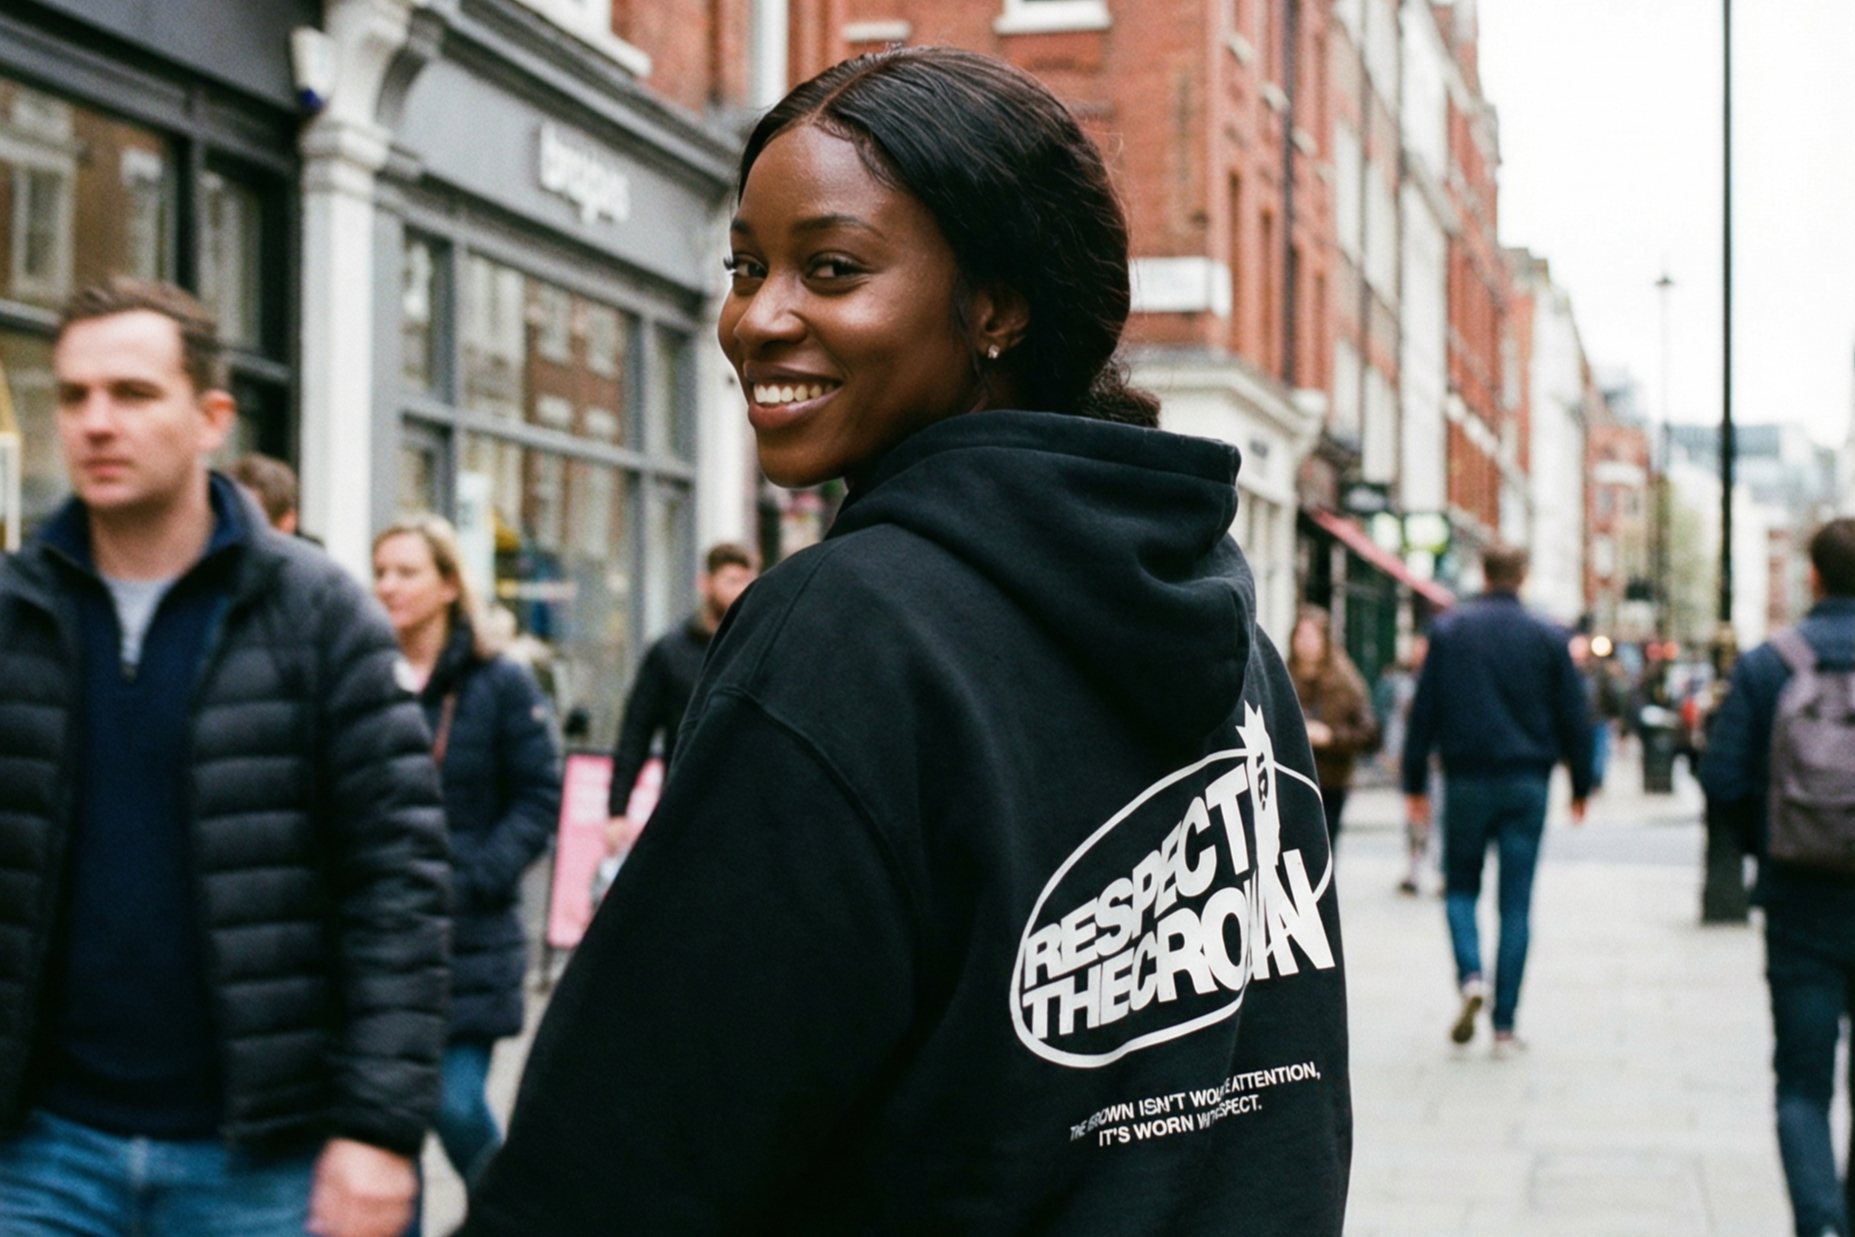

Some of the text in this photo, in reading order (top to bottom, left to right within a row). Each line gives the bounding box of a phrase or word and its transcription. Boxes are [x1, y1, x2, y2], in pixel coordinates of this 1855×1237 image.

[1024, 763, 1250, 990] RESPECT
[1138, 1092, 1186, 1117] ISN'T
[1231, 1061, 1321, 1092] ATTENTION,
[1099, 1126, 1131, 1147] IT'S
[1133, 1114, 1194, 1141] WORN
